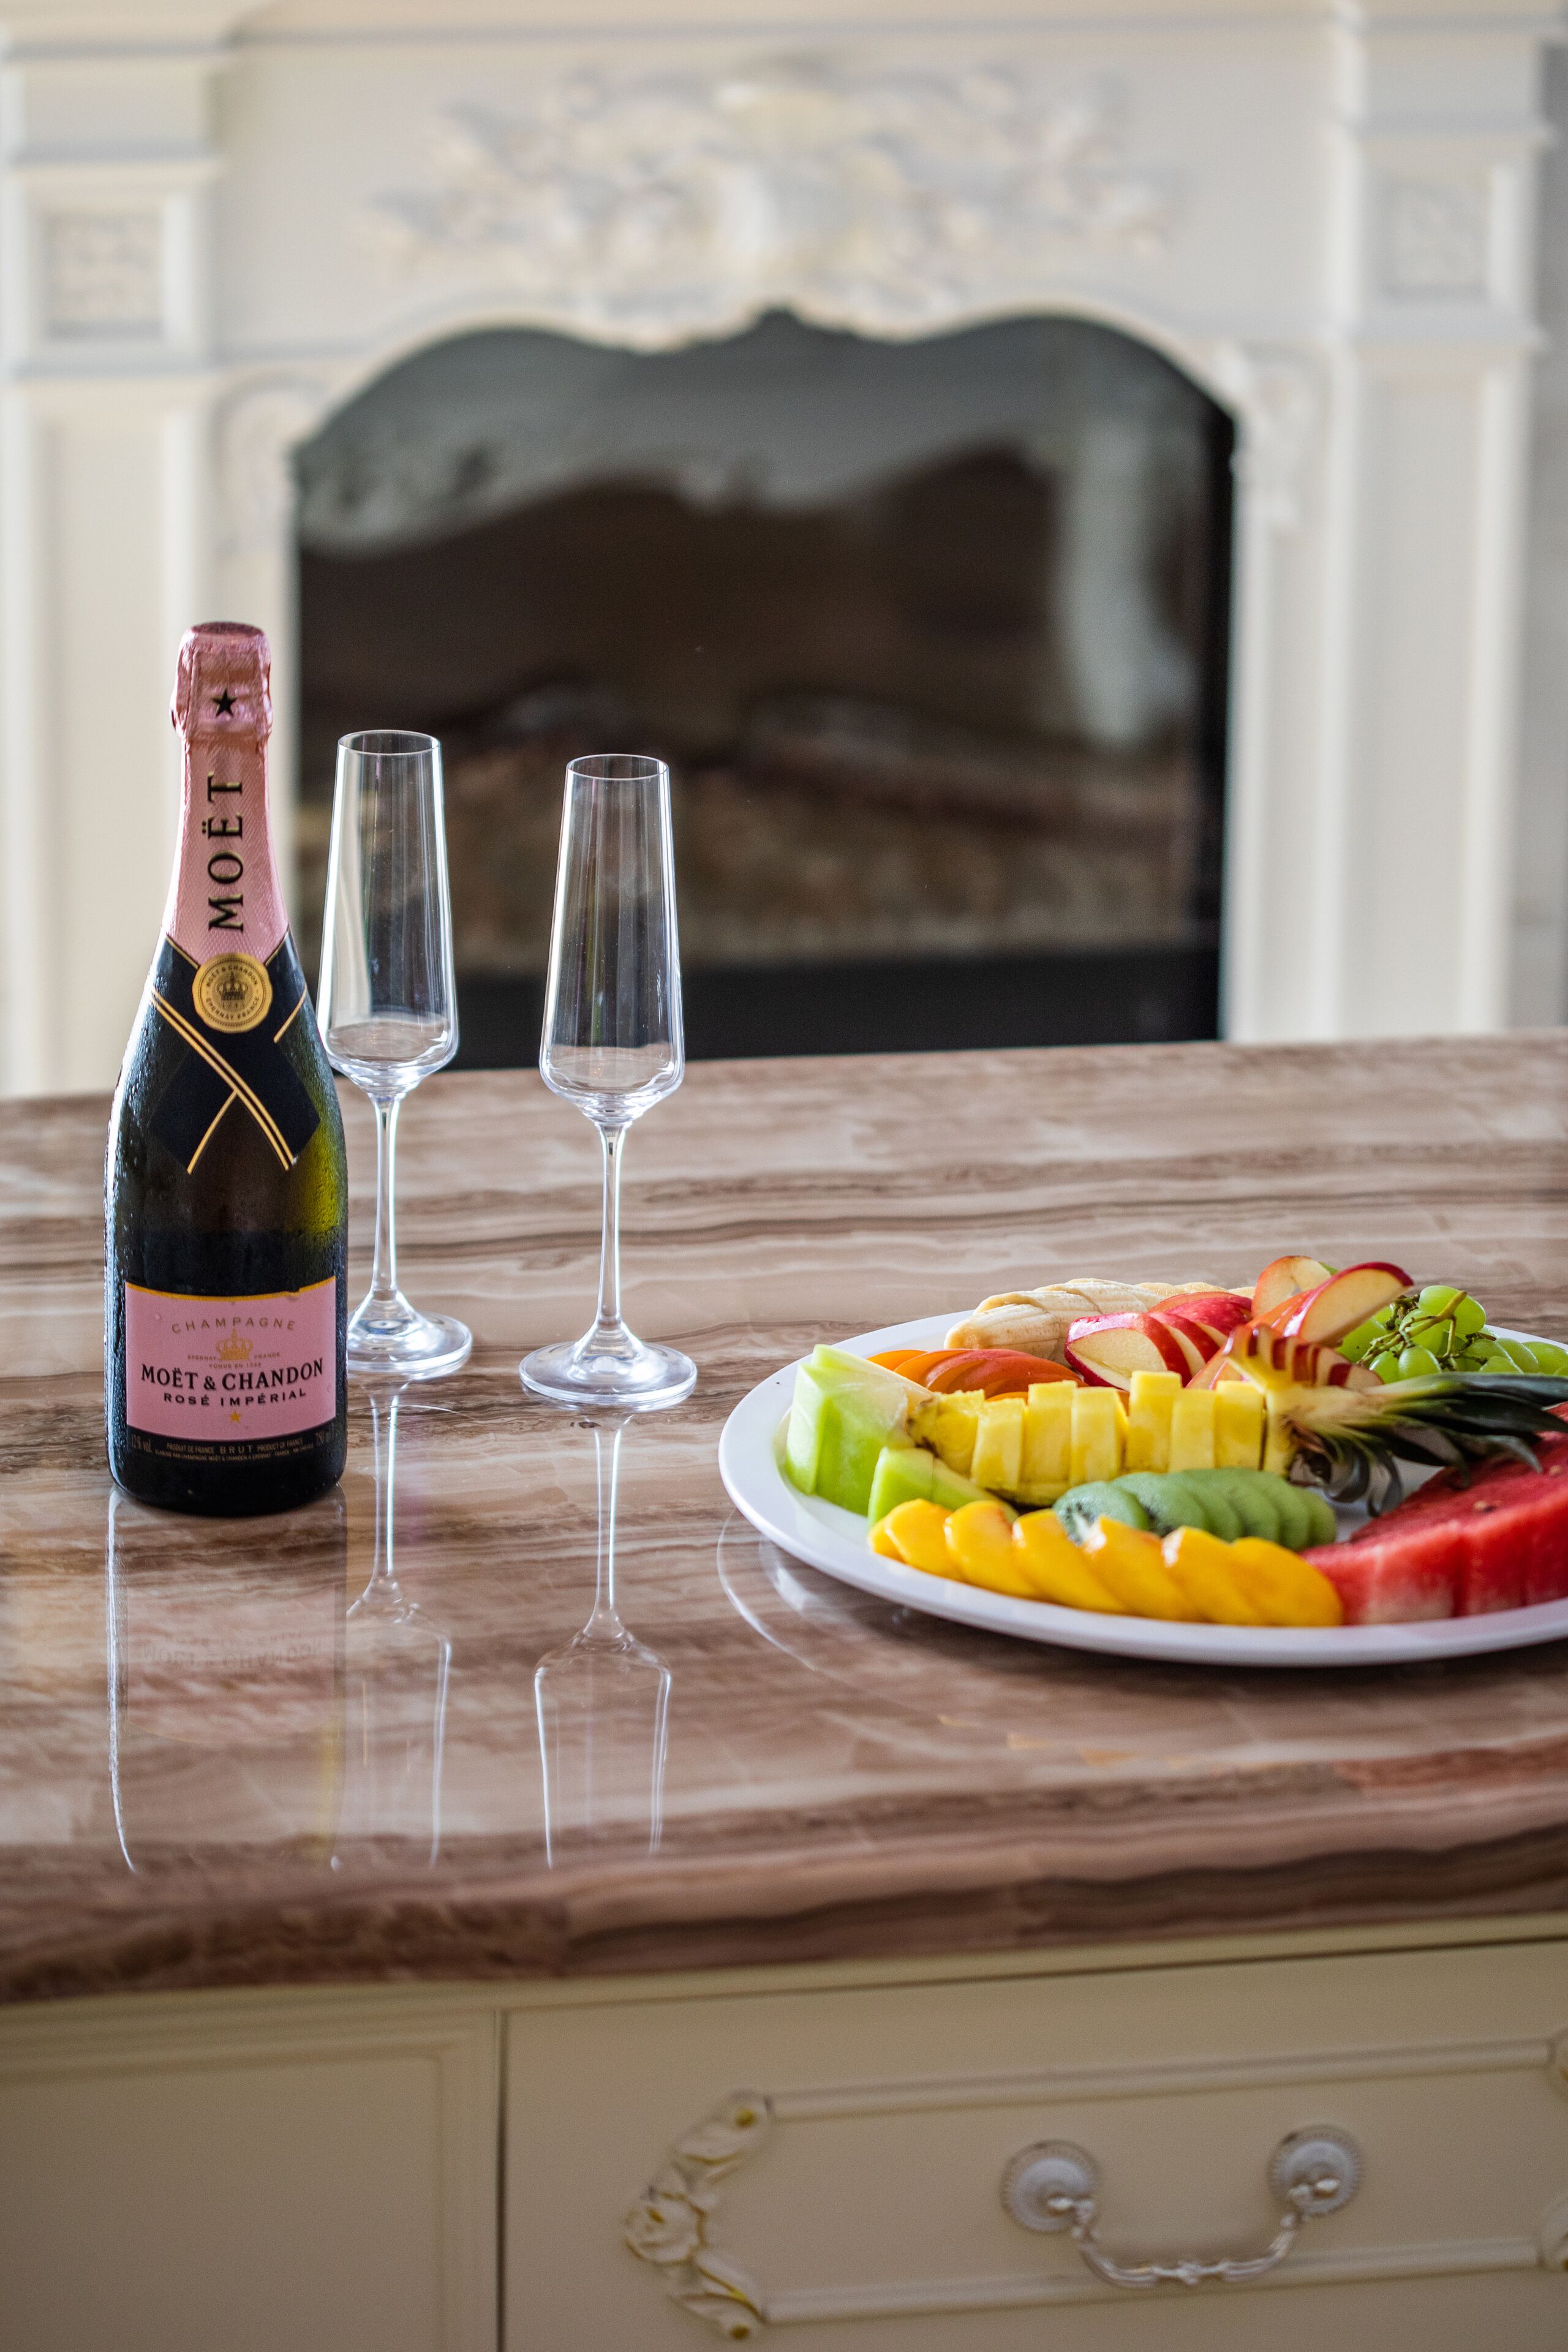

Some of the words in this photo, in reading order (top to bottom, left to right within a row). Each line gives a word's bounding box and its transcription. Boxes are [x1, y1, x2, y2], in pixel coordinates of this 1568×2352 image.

[201, 771, 244, 932] MOËT
[172, 1317, 296, 1334] CHAMPAGNE
[140, 1363, 198, 1390] MOËT
[203, 1375, 217, 1390] &
[221, 1357, 323, 1391] CHANDON
[163, 1392, 210, 1406] ROSÉ
[220, 1388, 307, 1407] IMPÉRIAL
[166, 1441, 186, 1452] PRODUIT
[195, 1446, 214, 1455] FRANCE
[219, 1444, 254, 1455] BRUT
[257, 1442, 279, 1452] PRODUCT
[287, 1438, 304, 1447] FRANCE
